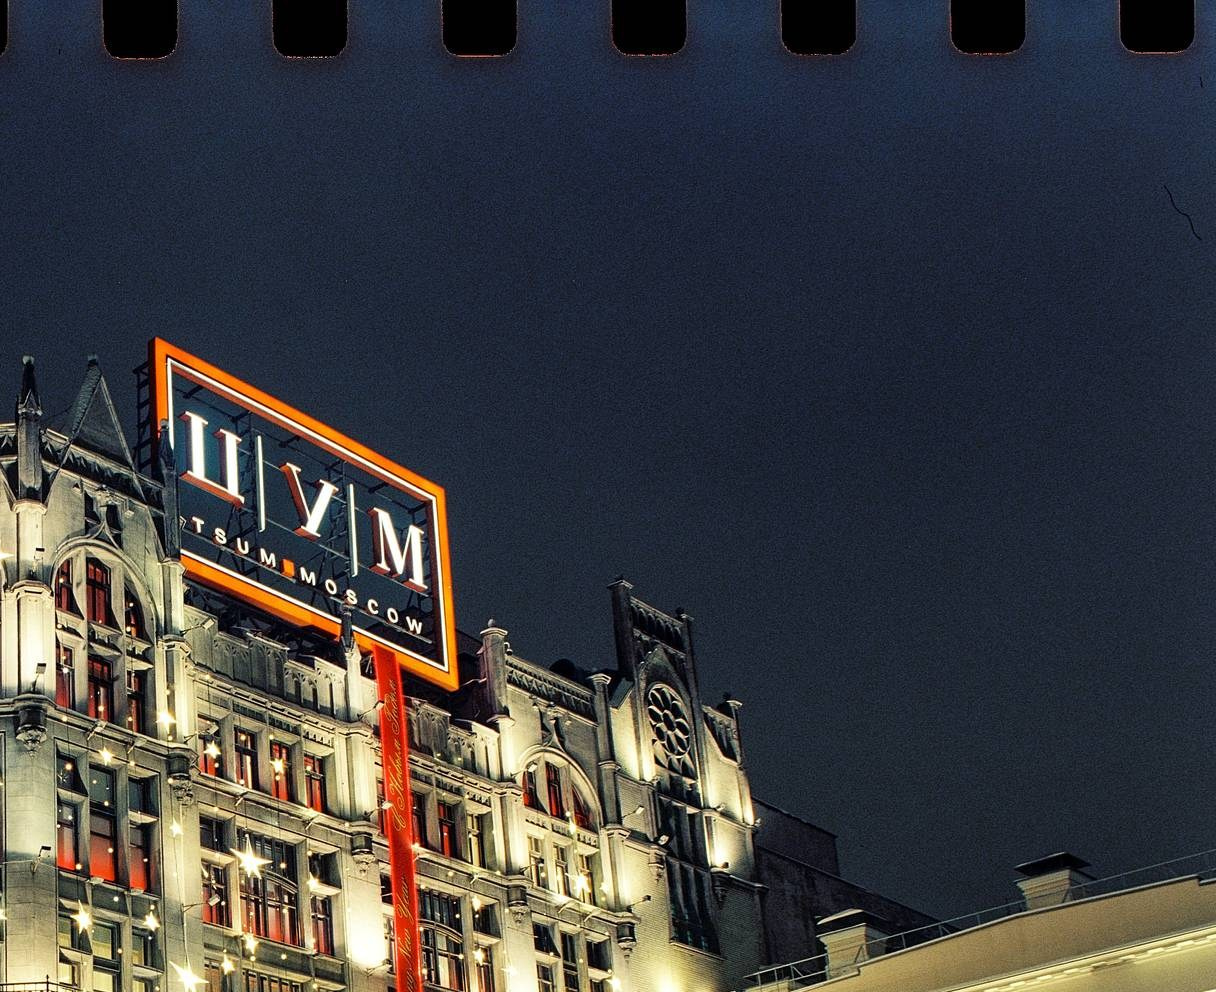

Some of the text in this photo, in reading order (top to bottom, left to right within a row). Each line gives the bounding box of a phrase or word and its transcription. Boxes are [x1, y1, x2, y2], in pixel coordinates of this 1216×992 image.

[191, 515, 423, 635] TSUM MOSCOW
[395, 876, 415, 925] Year
[397, 928, 413, 970] New
